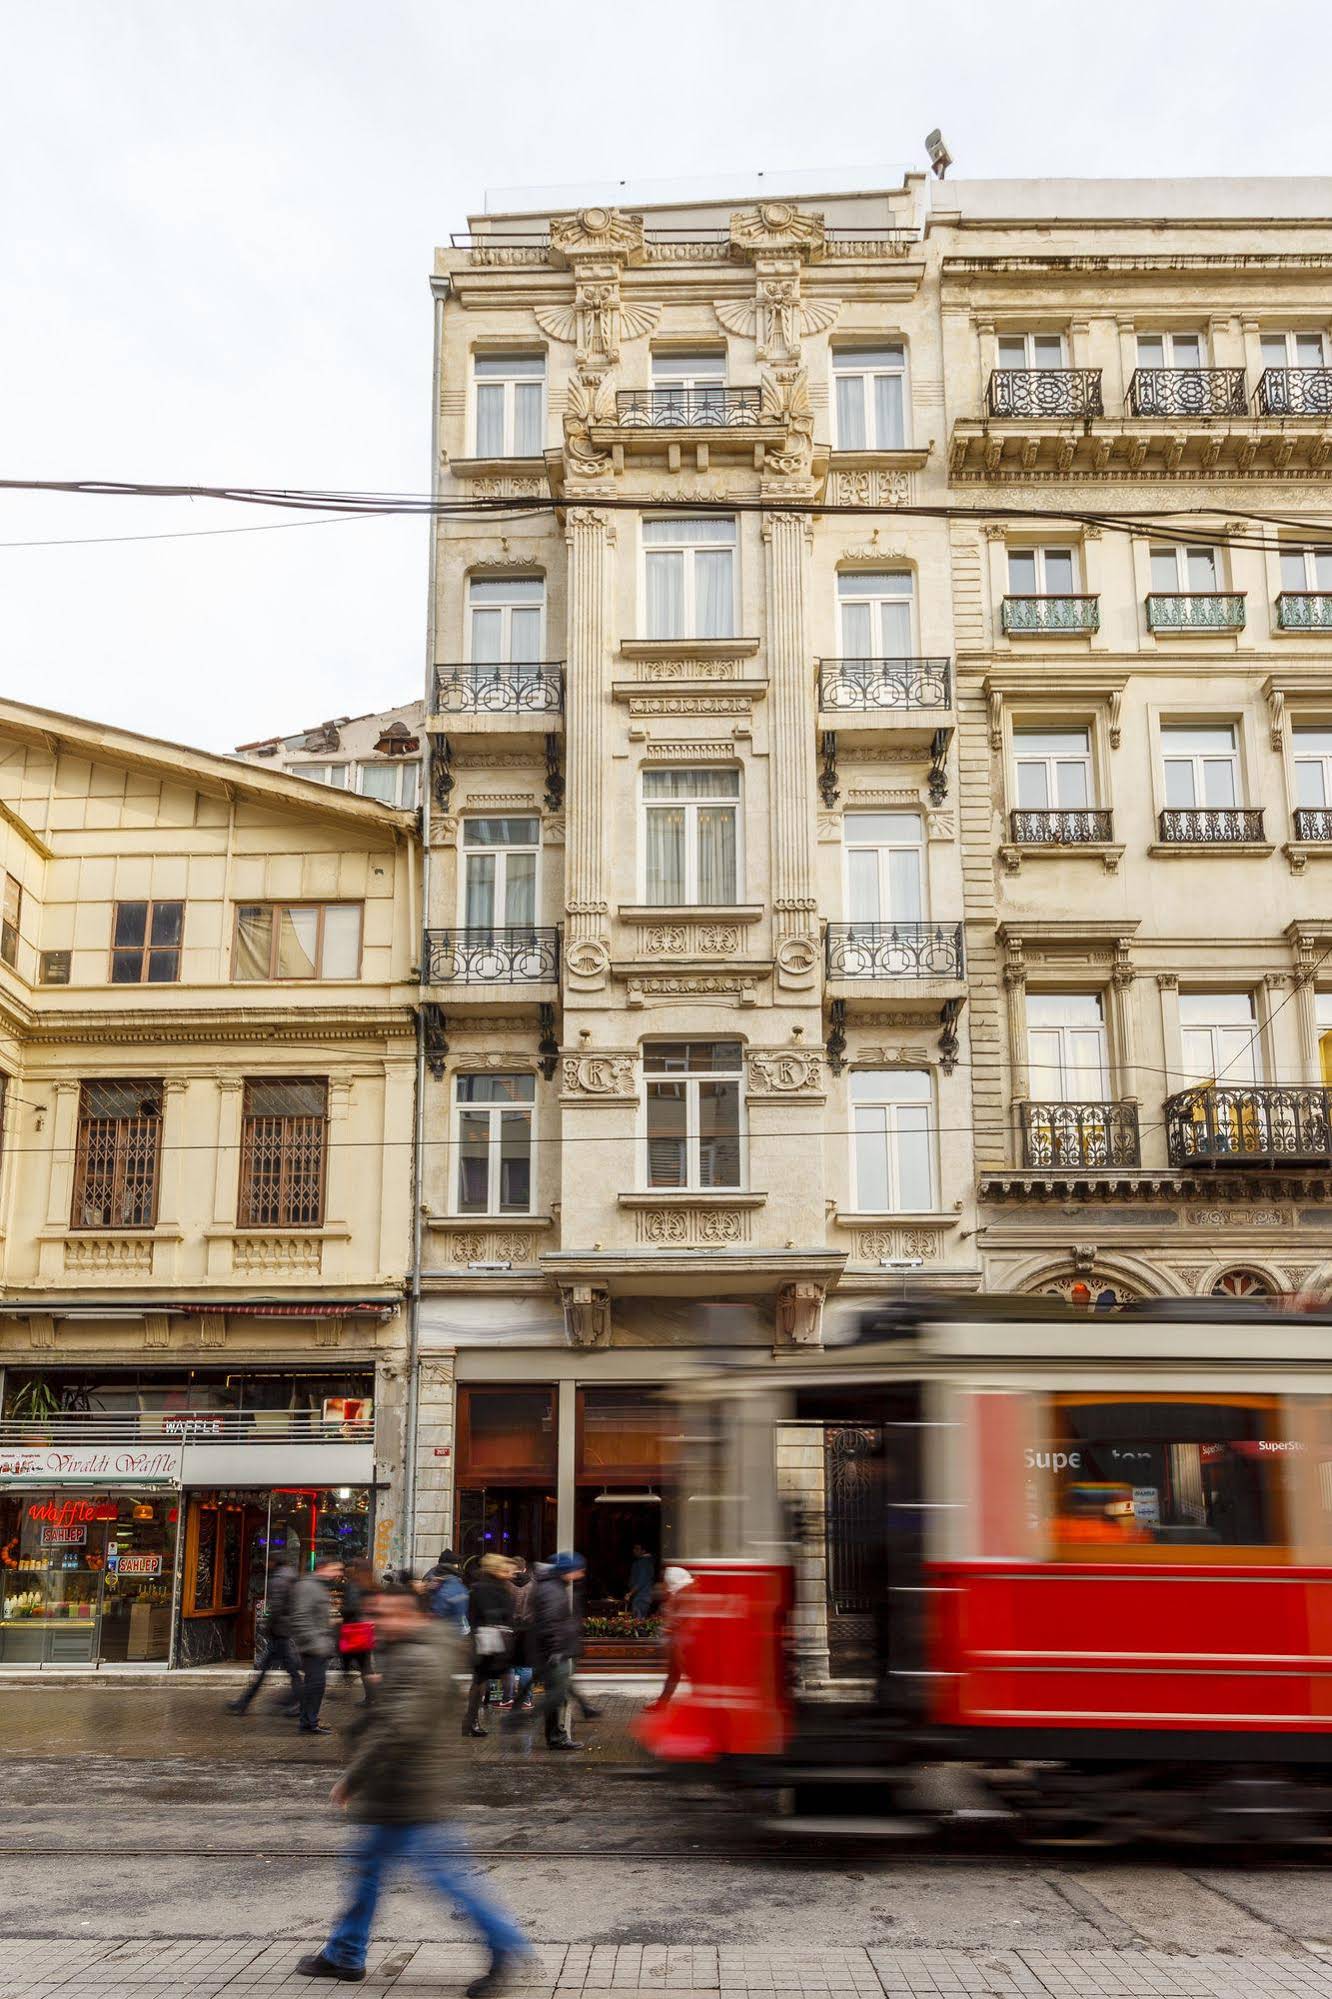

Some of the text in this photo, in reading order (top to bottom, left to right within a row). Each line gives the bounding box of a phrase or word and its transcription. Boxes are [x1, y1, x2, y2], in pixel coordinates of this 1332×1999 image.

[47, 1453, 177, 1479] Vivaldi Waffle
[44, 1528, 84, 1543] SAHLEP
[119, 1558, 158, 1572] SAHLEP
